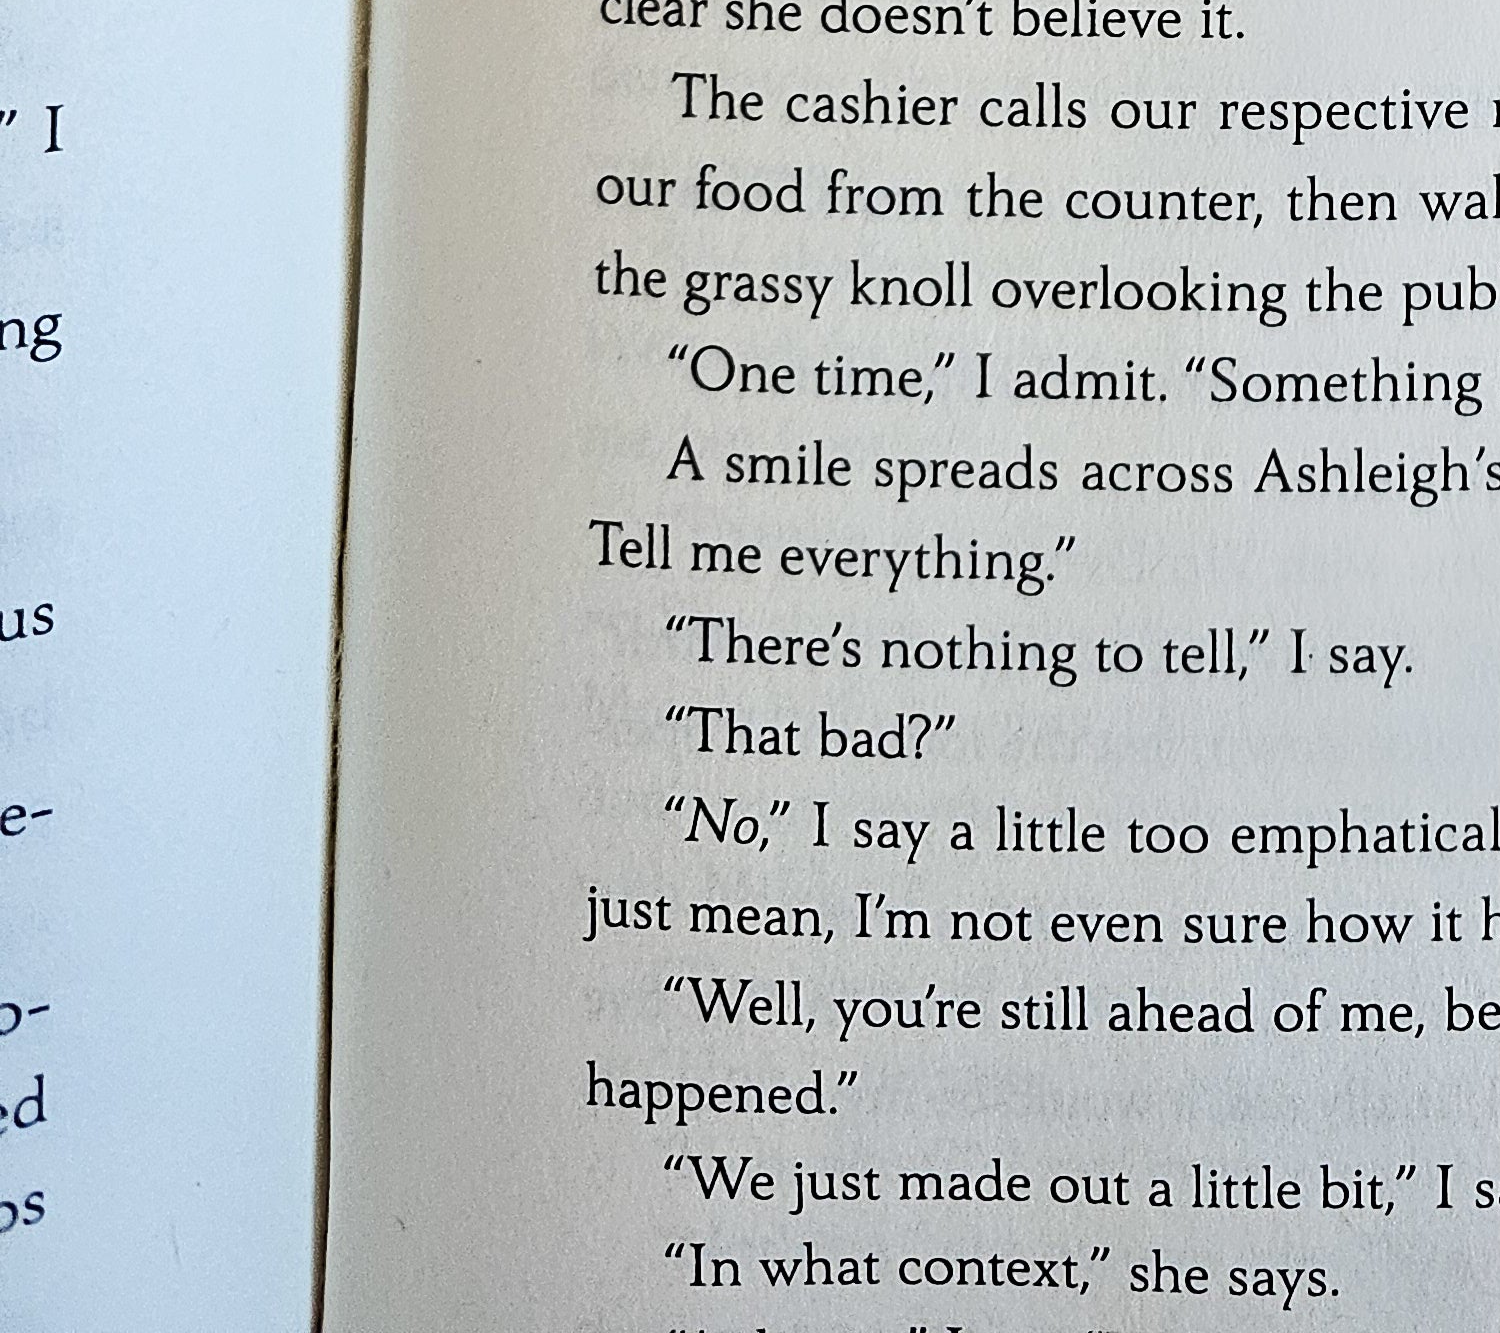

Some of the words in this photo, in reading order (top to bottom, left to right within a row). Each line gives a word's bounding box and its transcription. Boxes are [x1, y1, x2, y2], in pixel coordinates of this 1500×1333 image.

[670, 71, 764, 122] The
[785, 77, 959, 126] cashier
[979, 81, 1087, 129] calls
[1110, 99, 1197, 130] our
[1219, 88, 1469, 146] respective
[596, 174, 677, 208] our
[695, 163, 807, 214] food
[826, 167, 945, 217] from
[966, 171, 1044, 219] the
[1065, 186, 1263, 230] counter,
[1286, 174, 1398, 222] then
[594, 248, 667, 299] the
[683, 270, 835, 320] grassy
[849, 258, 974, 308] knoll
[991, 263, 1288, 328] overlooking
[1305, 265, 1383, 313] the
[667, 343, 796, 395] “One
[813, 351, 956, 406] time,”
[975, 351, 993, 399] I
[1013, 353, 1167, 404] admit.
[1185, 355, 1483, 418] “Something
[665, 433, 706, 482] A
[725, 439, 852, 487] smile
[874, 442, 1058, 503] spreads
[1081, 461, 1233, 494] across
[588, 518, 673, 570] Tell
[690, 542, 762, 575] me
[780, 532, 1076, 597] everything.”
[664, 794, 791, 853] “No,”
[812, 800, 830, 848] I
[853, 818, 931, 865] say
[950, 821, 975, 851] a
[995, 804, 1106, 854] little
[1127, 817, 1209, 854] too
[581, 885, 672, 943] just
[689, 903, 834, 945] mean,
[854, 892, 932, 939] I’m
[950, 906, 1033, 942] not
[1050, 913, 1164, 943] even
[1183, 913, 1287, 944] sure
[1305, 896, 1415, 945] how
[1430, 900, 1463, 943] it
[663, 975, 815, 1034] “Well,
[832, 983, 981, 1043] you’re
[1001, 984, 1089, 1031] still
[1108, 985, 1255, 1034] ahead
[1273, 986, 1328, 1033] of
[1340, 1003, 1425, 1039] me,
[585, 1059, 858, 1127] happened.”
[664, 1242, 742, 1287] “In
[758, 1241, 881, 1287] what
[898, 1245, 1111, 1296] context,”
[1129, 1248, 1209, 1295] she
[1228, 1267, 1339, 1312] says.
